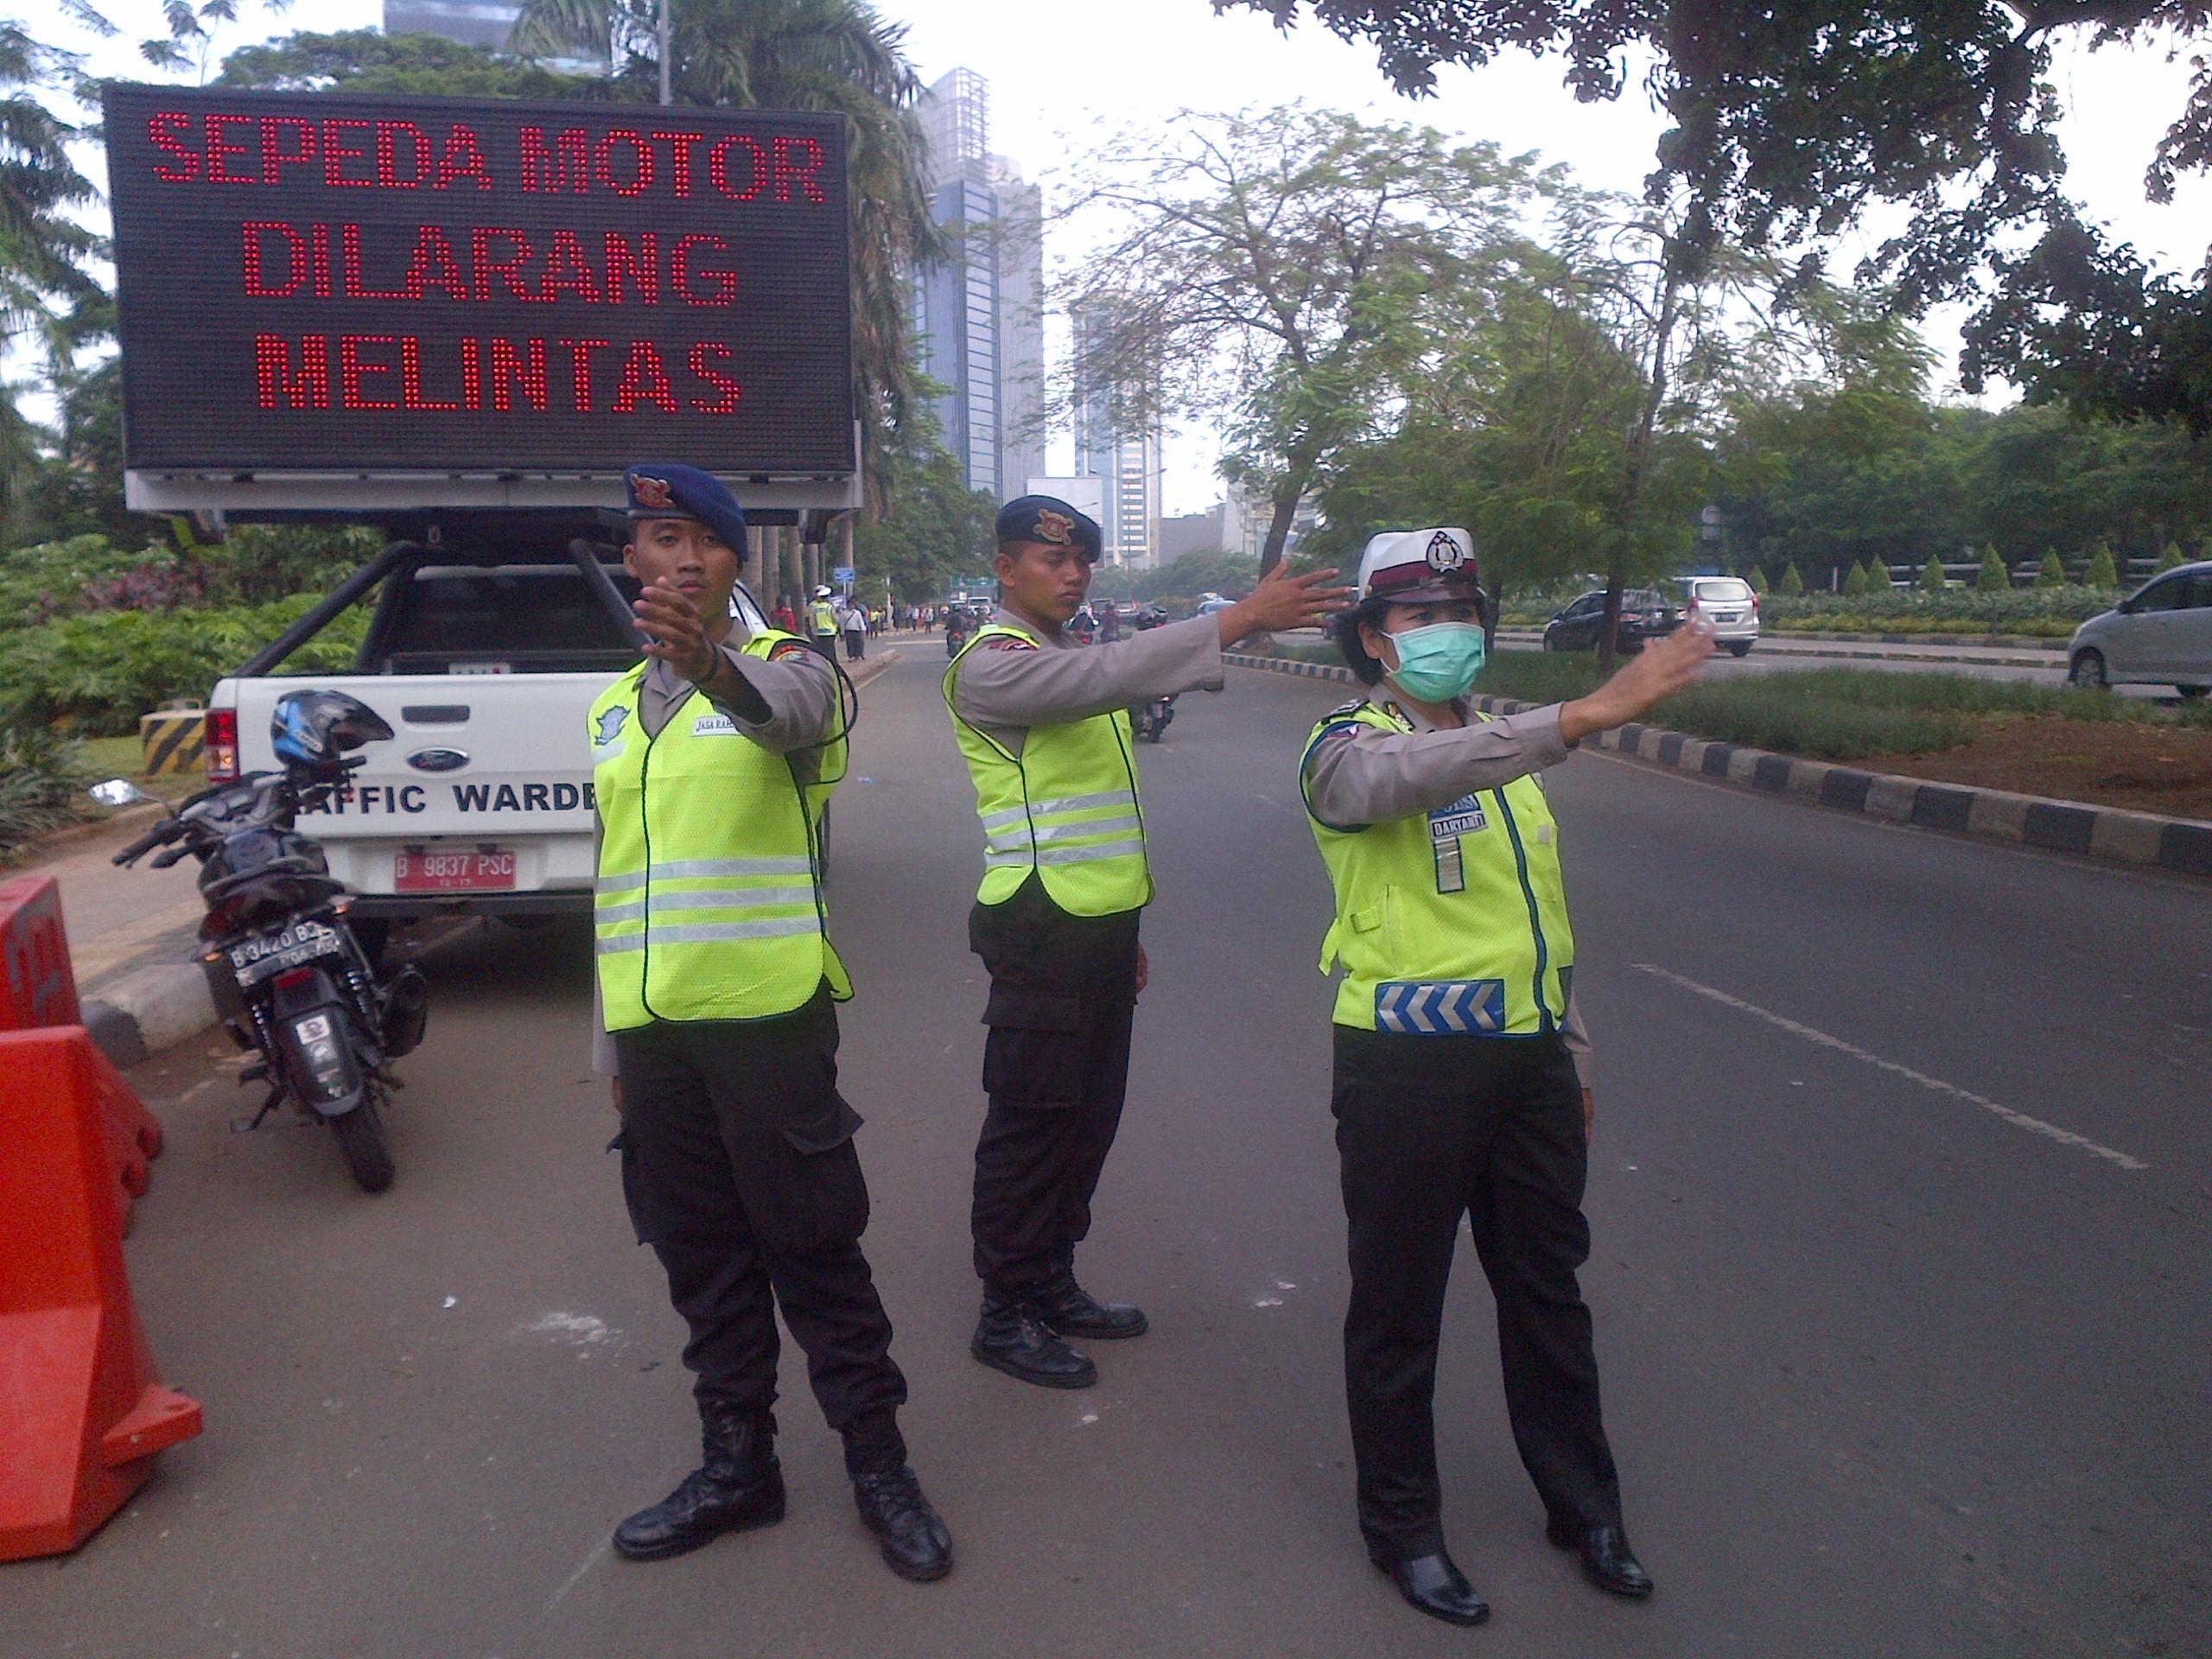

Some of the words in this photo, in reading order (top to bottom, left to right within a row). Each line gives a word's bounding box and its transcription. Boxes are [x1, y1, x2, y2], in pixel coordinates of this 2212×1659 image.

[148, 111, 493, 190] SEPEDA
[519, 126, 826, 203] MOTOR
[242, 221, 736, 306] DILARANG
[255, 334, 741, 414] MELINTAS
[294, 784, 426, 814] AFFIC
[452, 783, 594, 812] WARDE
[1433, 814, 1484, 836] DARYANTI
[397, 857, 409, 878] B
[423, 855, 470, 877] 9837
[478, 854, 512, 876] PSC
